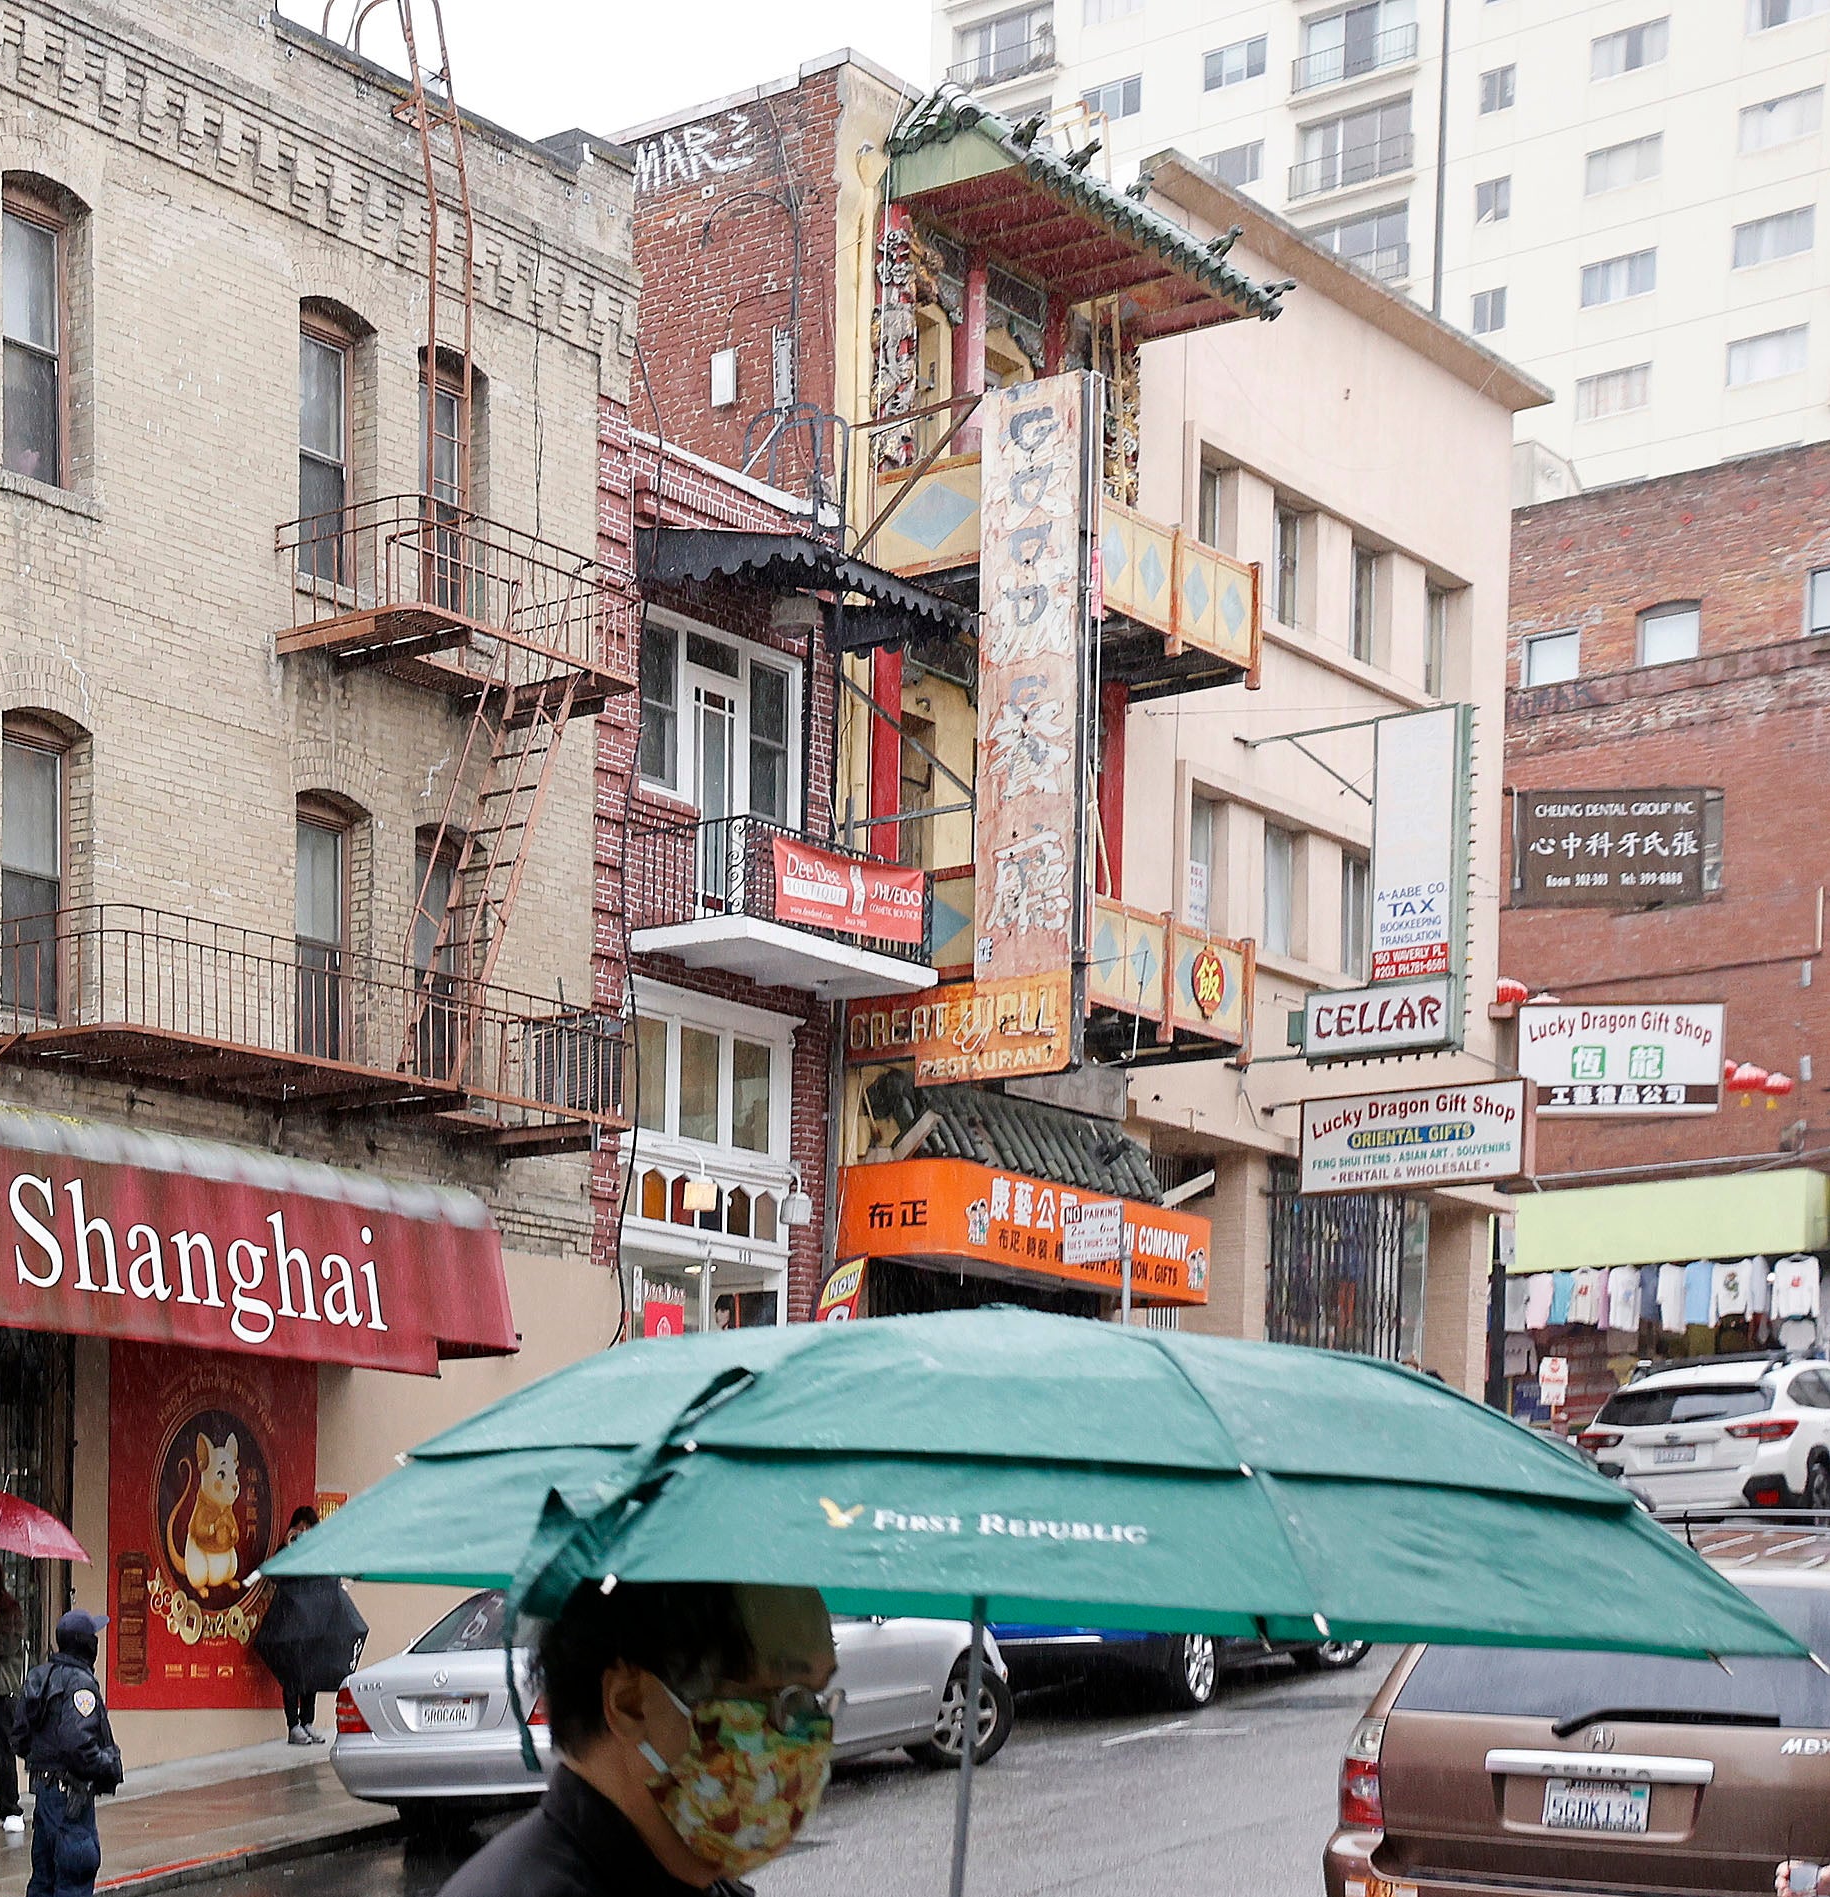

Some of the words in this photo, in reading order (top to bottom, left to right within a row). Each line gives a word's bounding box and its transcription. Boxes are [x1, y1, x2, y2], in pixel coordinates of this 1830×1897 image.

[1535, 803, 1583, 818] CHEUNG
[1585, 803, 1628, 817] DENTAL
[1630, 802, 1671, 816] GROUP
[871, 881, 923, 907] SHISEIDO
[1377, 885, 1422, 901] A-AABE
[1387, 898, 1435, 918] TAX
[1380, 915, 1442, 933] BOOKKEEPING
[1380, 929, 1442, 946] TRANSLATION
[1392, 946, 1429, 963] WAVERLY
[1196, 957, 1221, 1003] 飯
[850, 1003, 947, 1050] GREAT
[1315, 994, 1443, 1039] CELLAR
[1529, 1014, 1576, 1043] Lucky
[1581, 1011, 1636, 1034] Dragon
[1641, 1011, 1670, 1034] Gift
[1674, 1015, 1712, 1047] Shop
[918, 1038, 1061, 1078] RESTAURANT
[1312, 1107, 1362, 1140] Lucky
[1369, 1098, 1428, 1119] Dragon
[1436, 1093, 1466, 1112] Gift
[1473, 1095, 1516, 1123] Shop
[1352, 1130, 1423, 1148] ORIENTAL
[1429, 1124, 1472, 1142] GIFTS
[1312, 1159, 1336, 1170] FENG
[1339, 1156, 1361, 1168] SHUI
[1363, 1153, 1391, 1165] ITEMS
[1399, 1151, 1427, 1163] ASIAN
[1430, 1148, 1447, 1159] ART
[1457, 1142, 1511, 1157] SOUVENIRS
[1393, 1167, 1402, 1179] &
[1406, 1161, 1481, 1178] WHOLESALE
[1065, 1206, 1082, 1223] NO
[1084, 1207, 1119, 1220] PARKING
[1138, 1225, 1189, 1262] COMPANY
[8, 1172, 391, 1344] Shanghai
[828, 1269, 859, 1300] NOW
[1154, 1264, 1177, 1286] GIFTS
